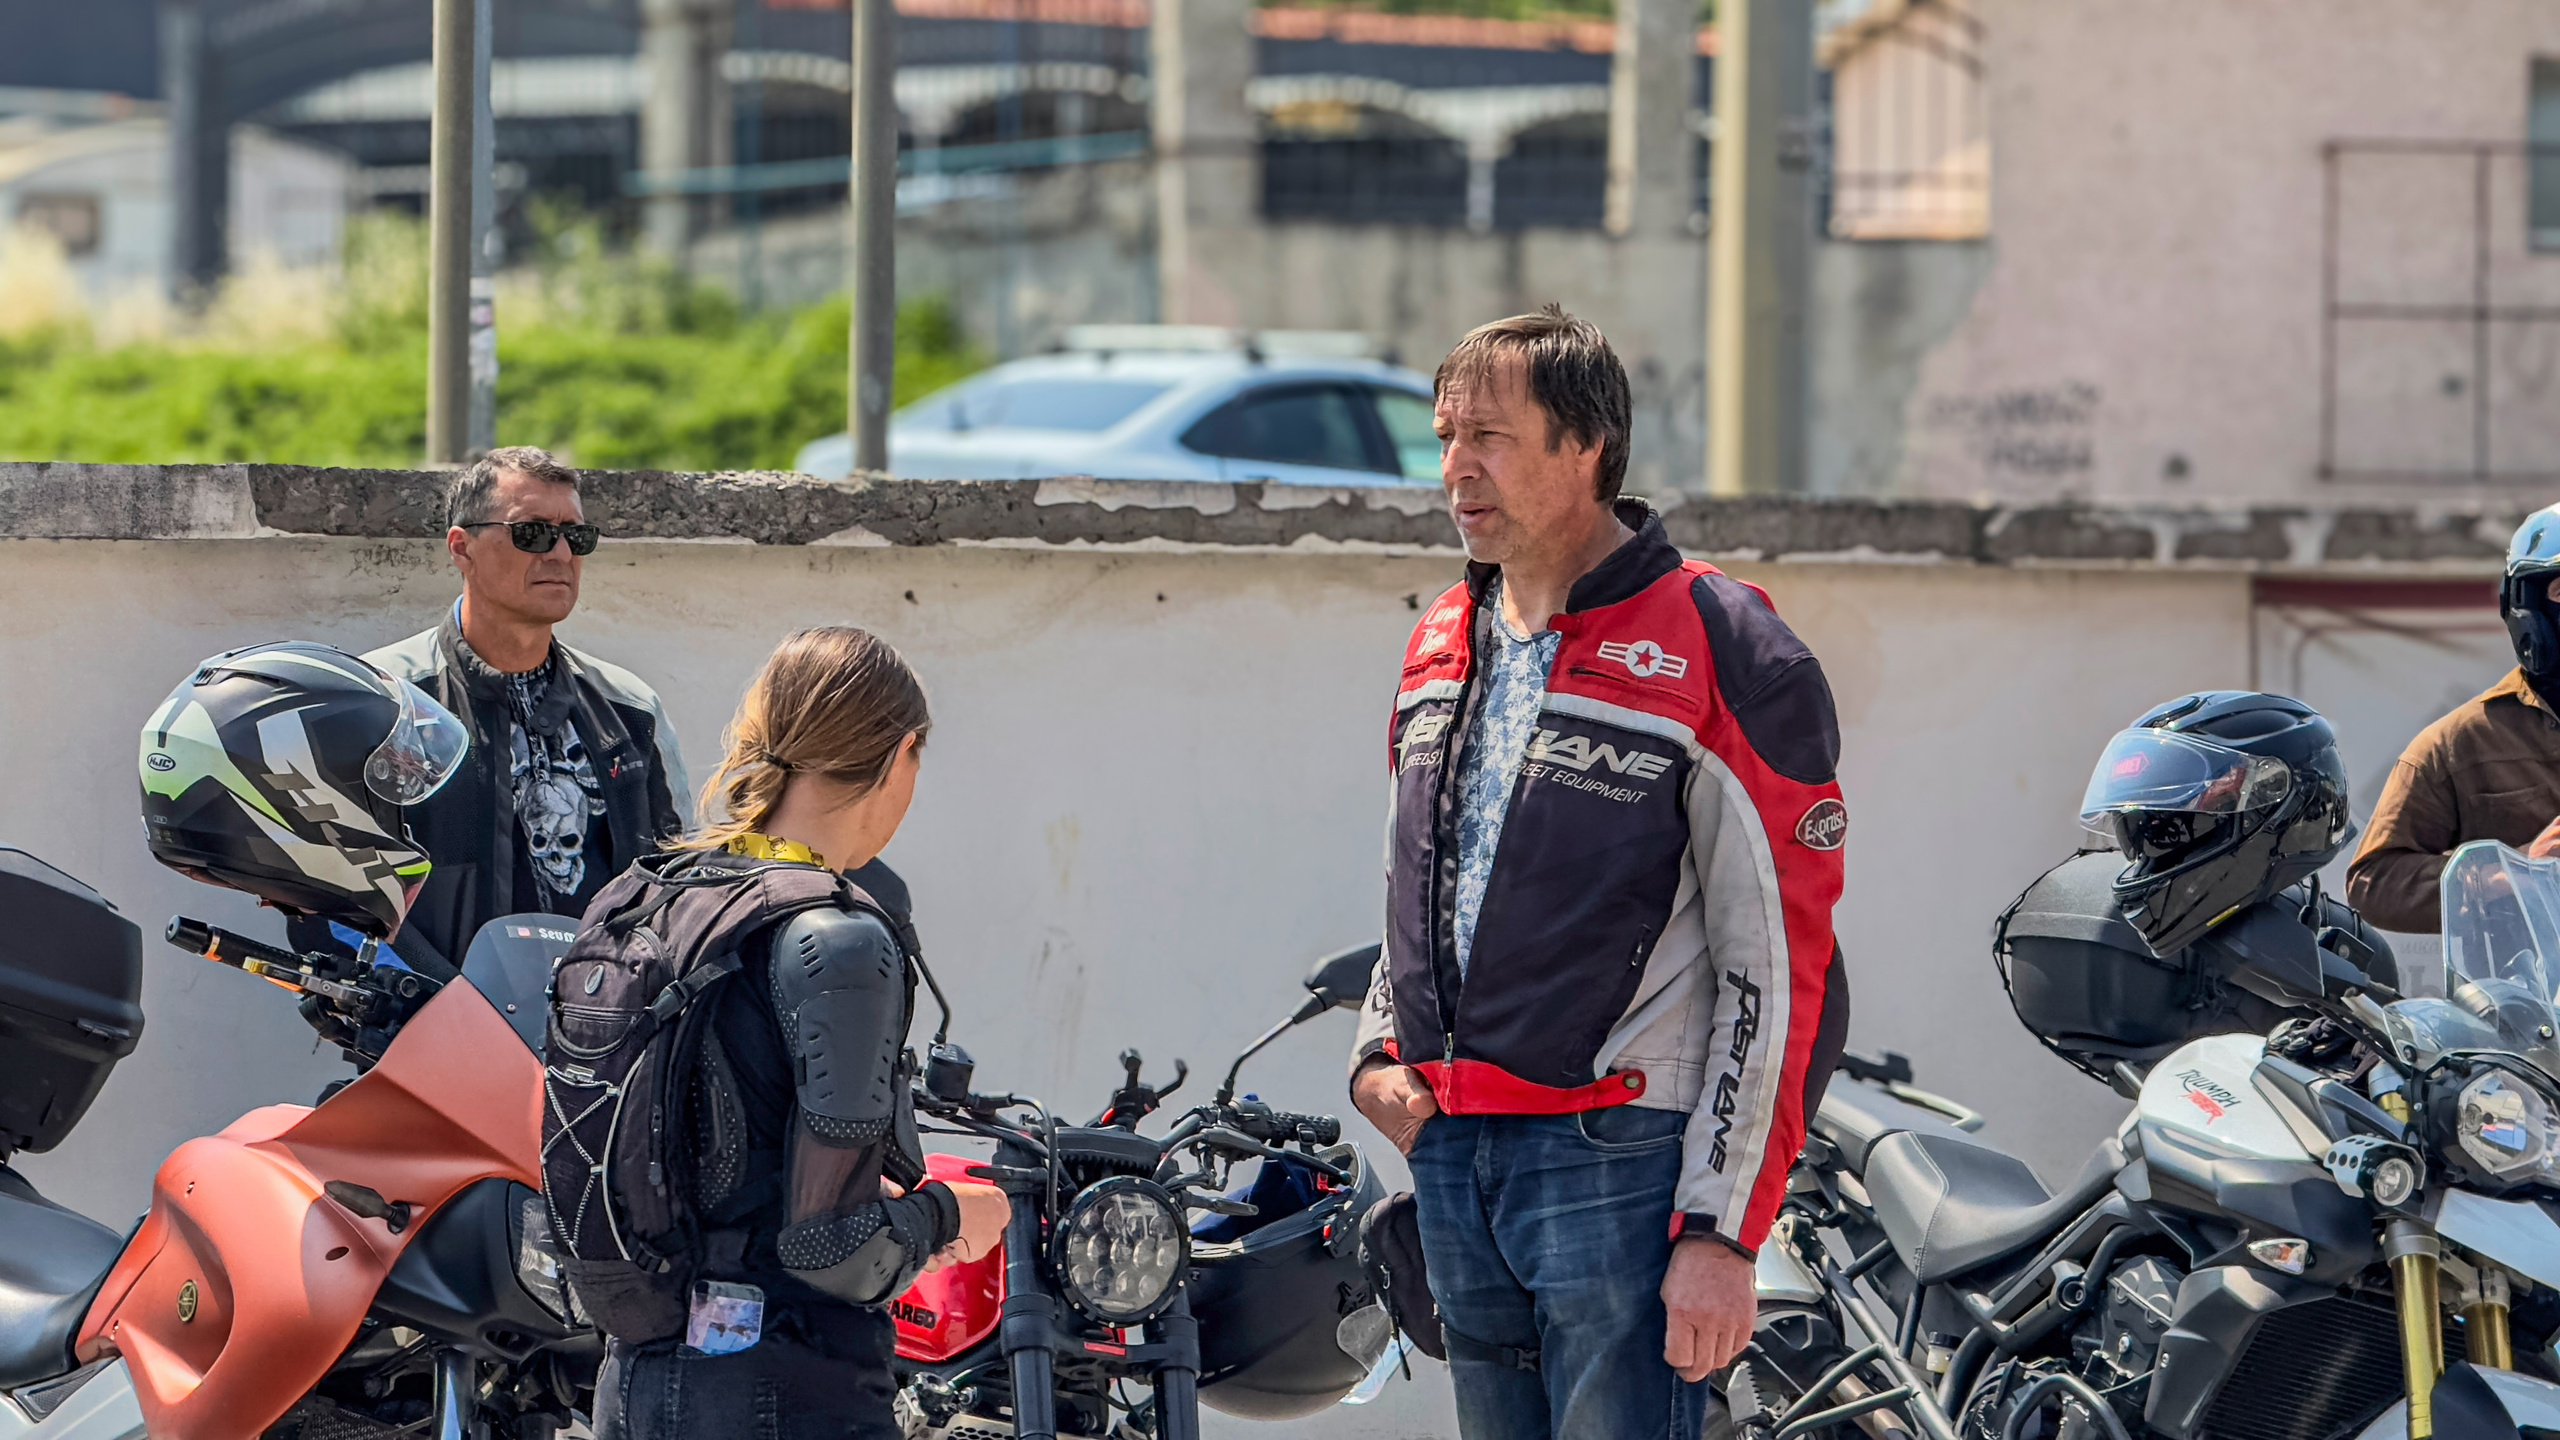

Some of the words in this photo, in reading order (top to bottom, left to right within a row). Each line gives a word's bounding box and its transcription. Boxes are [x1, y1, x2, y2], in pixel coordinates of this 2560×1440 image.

[149, 756, 172, 769] HJC
[1551, 769, 1648, 804] EQUIPMENT
[1726, 967, 1762, 1079] FAST
[2174, 1068, 2242, 1108] TRIUMPH
[1707, 1071, 1741, 1176] LANE
[890, 1299, 936, 1330] ARED
